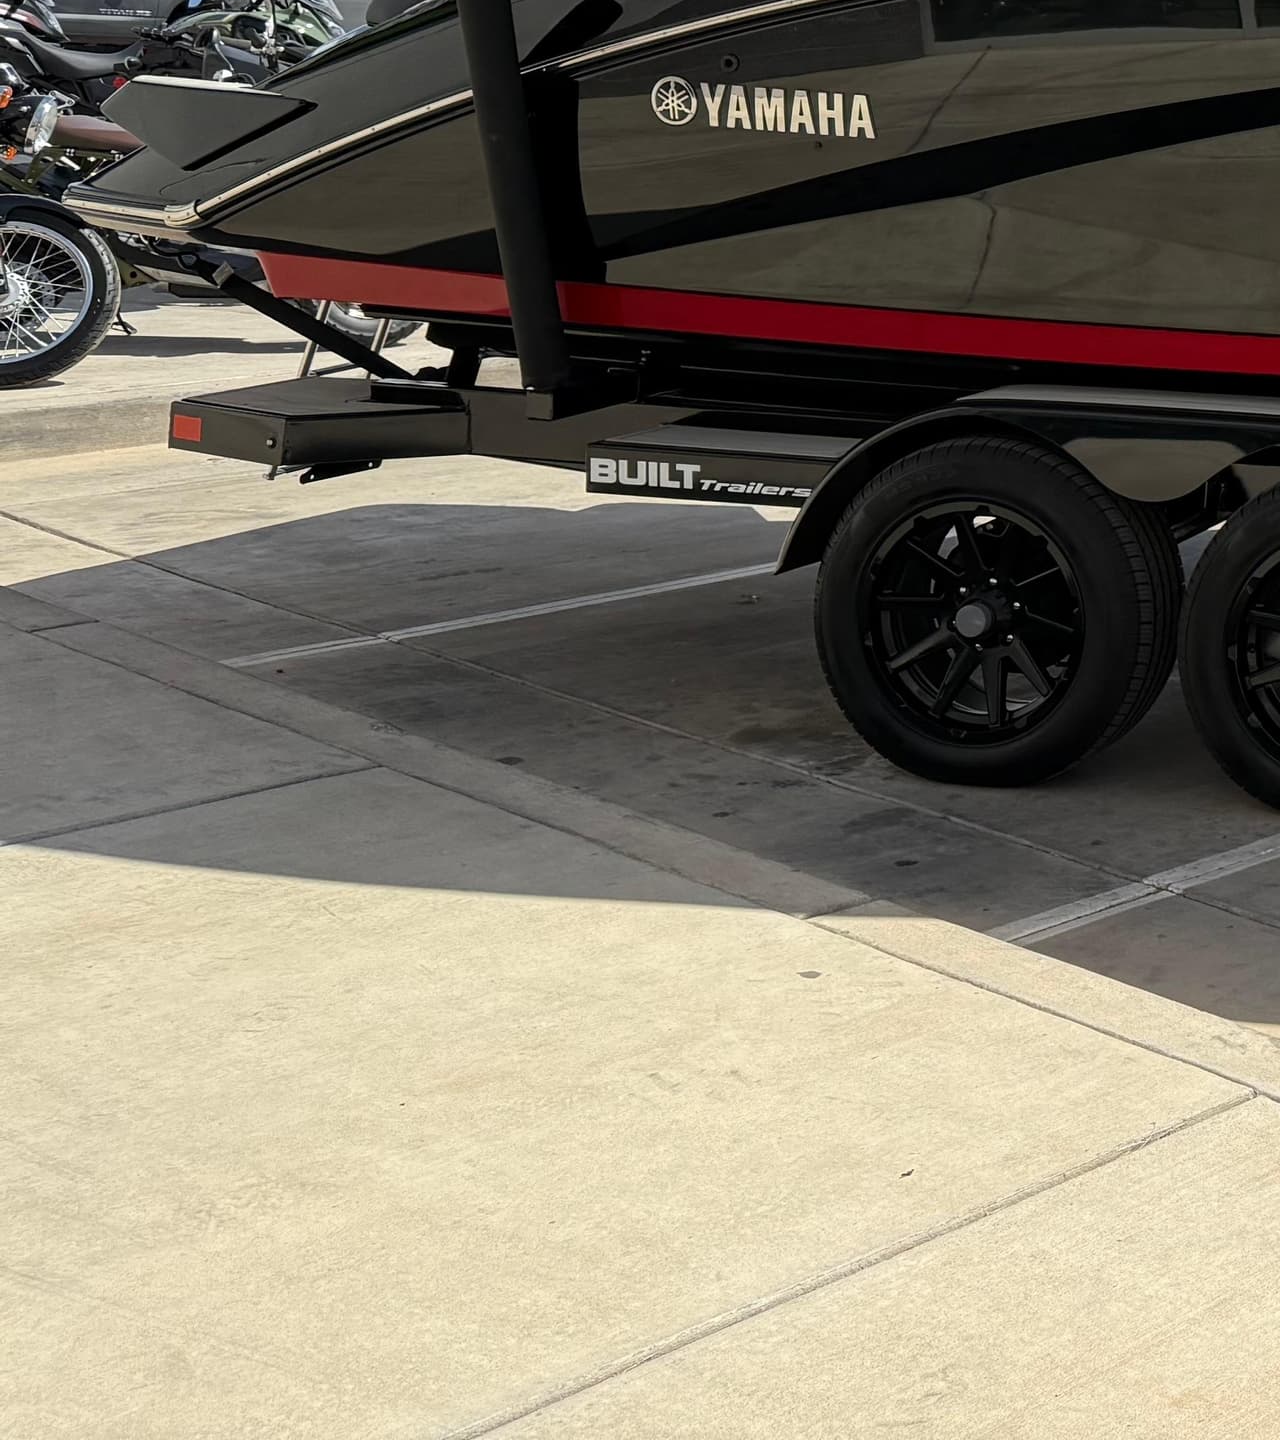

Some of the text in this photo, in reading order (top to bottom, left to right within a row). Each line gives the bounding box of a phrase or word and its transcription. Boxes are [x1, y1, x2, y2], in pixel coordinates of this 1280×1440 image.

[700, 82, 876, 139] YAMAHA
[590, 457, 813, 498] BUILT Trailers
